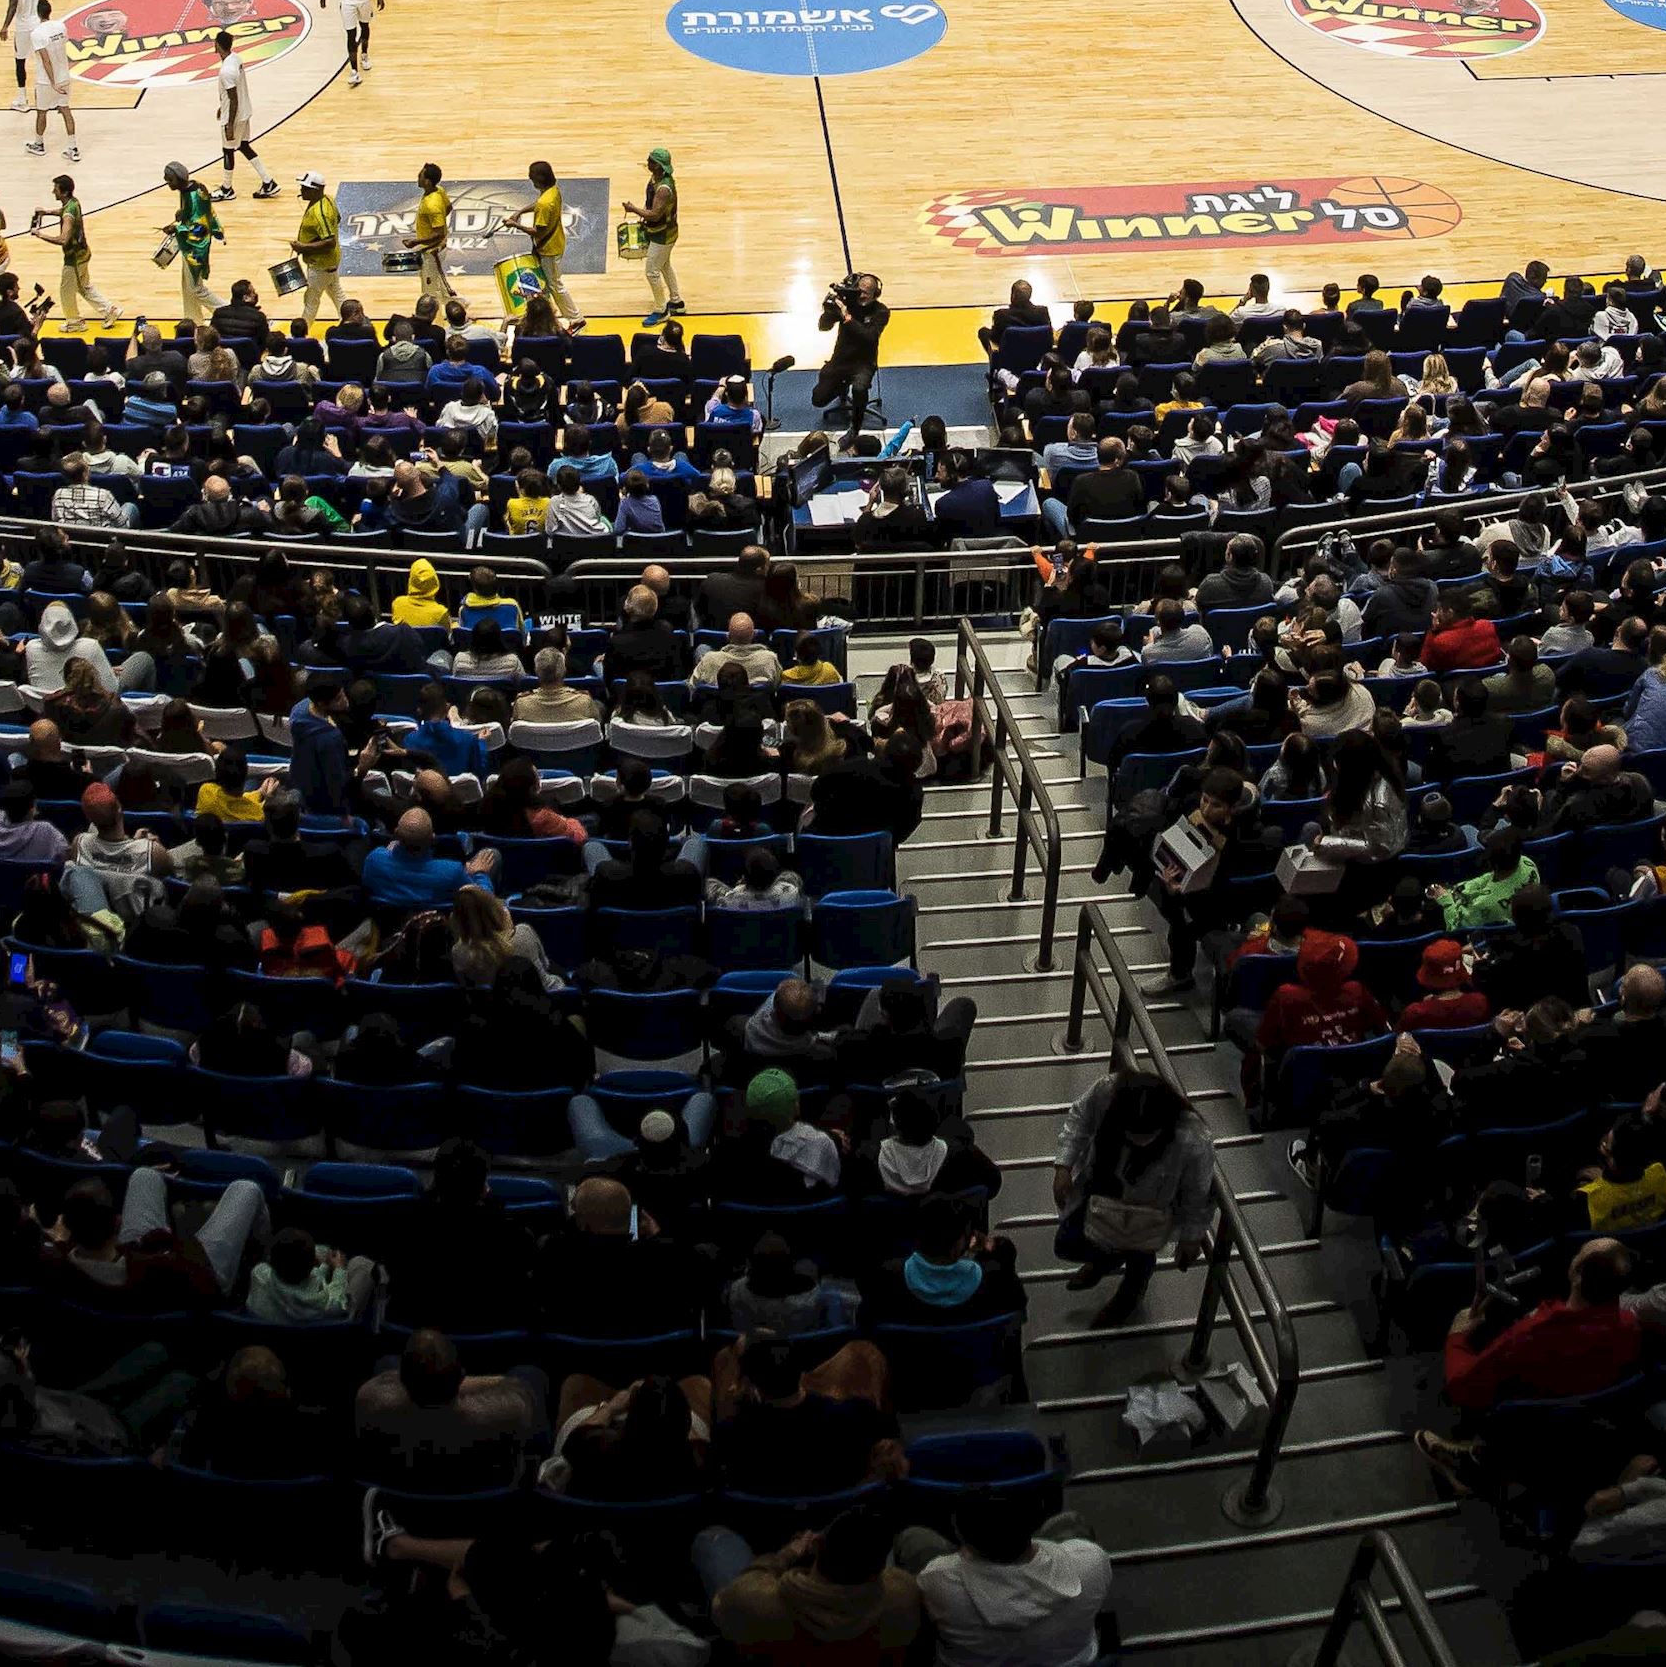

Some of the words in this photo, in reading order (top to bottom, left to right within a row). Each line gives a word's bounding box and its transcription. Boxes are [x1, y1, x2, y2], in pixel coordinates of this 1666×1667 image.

[682, 8, 874, 26] אשמורת
[684, 25, 741, 35] המורים
[749, 24, 826, 34] הסתדרות
[833, 24, 874, 33] מבית
[66, 14, 303, 60] Winner
[1192, 186, 1295, 213] ליגת
[980, 205, 1316, 243] Winner
[1321, 202, 1400, 230] סל
[538, 614, 582, 626] WHITE
